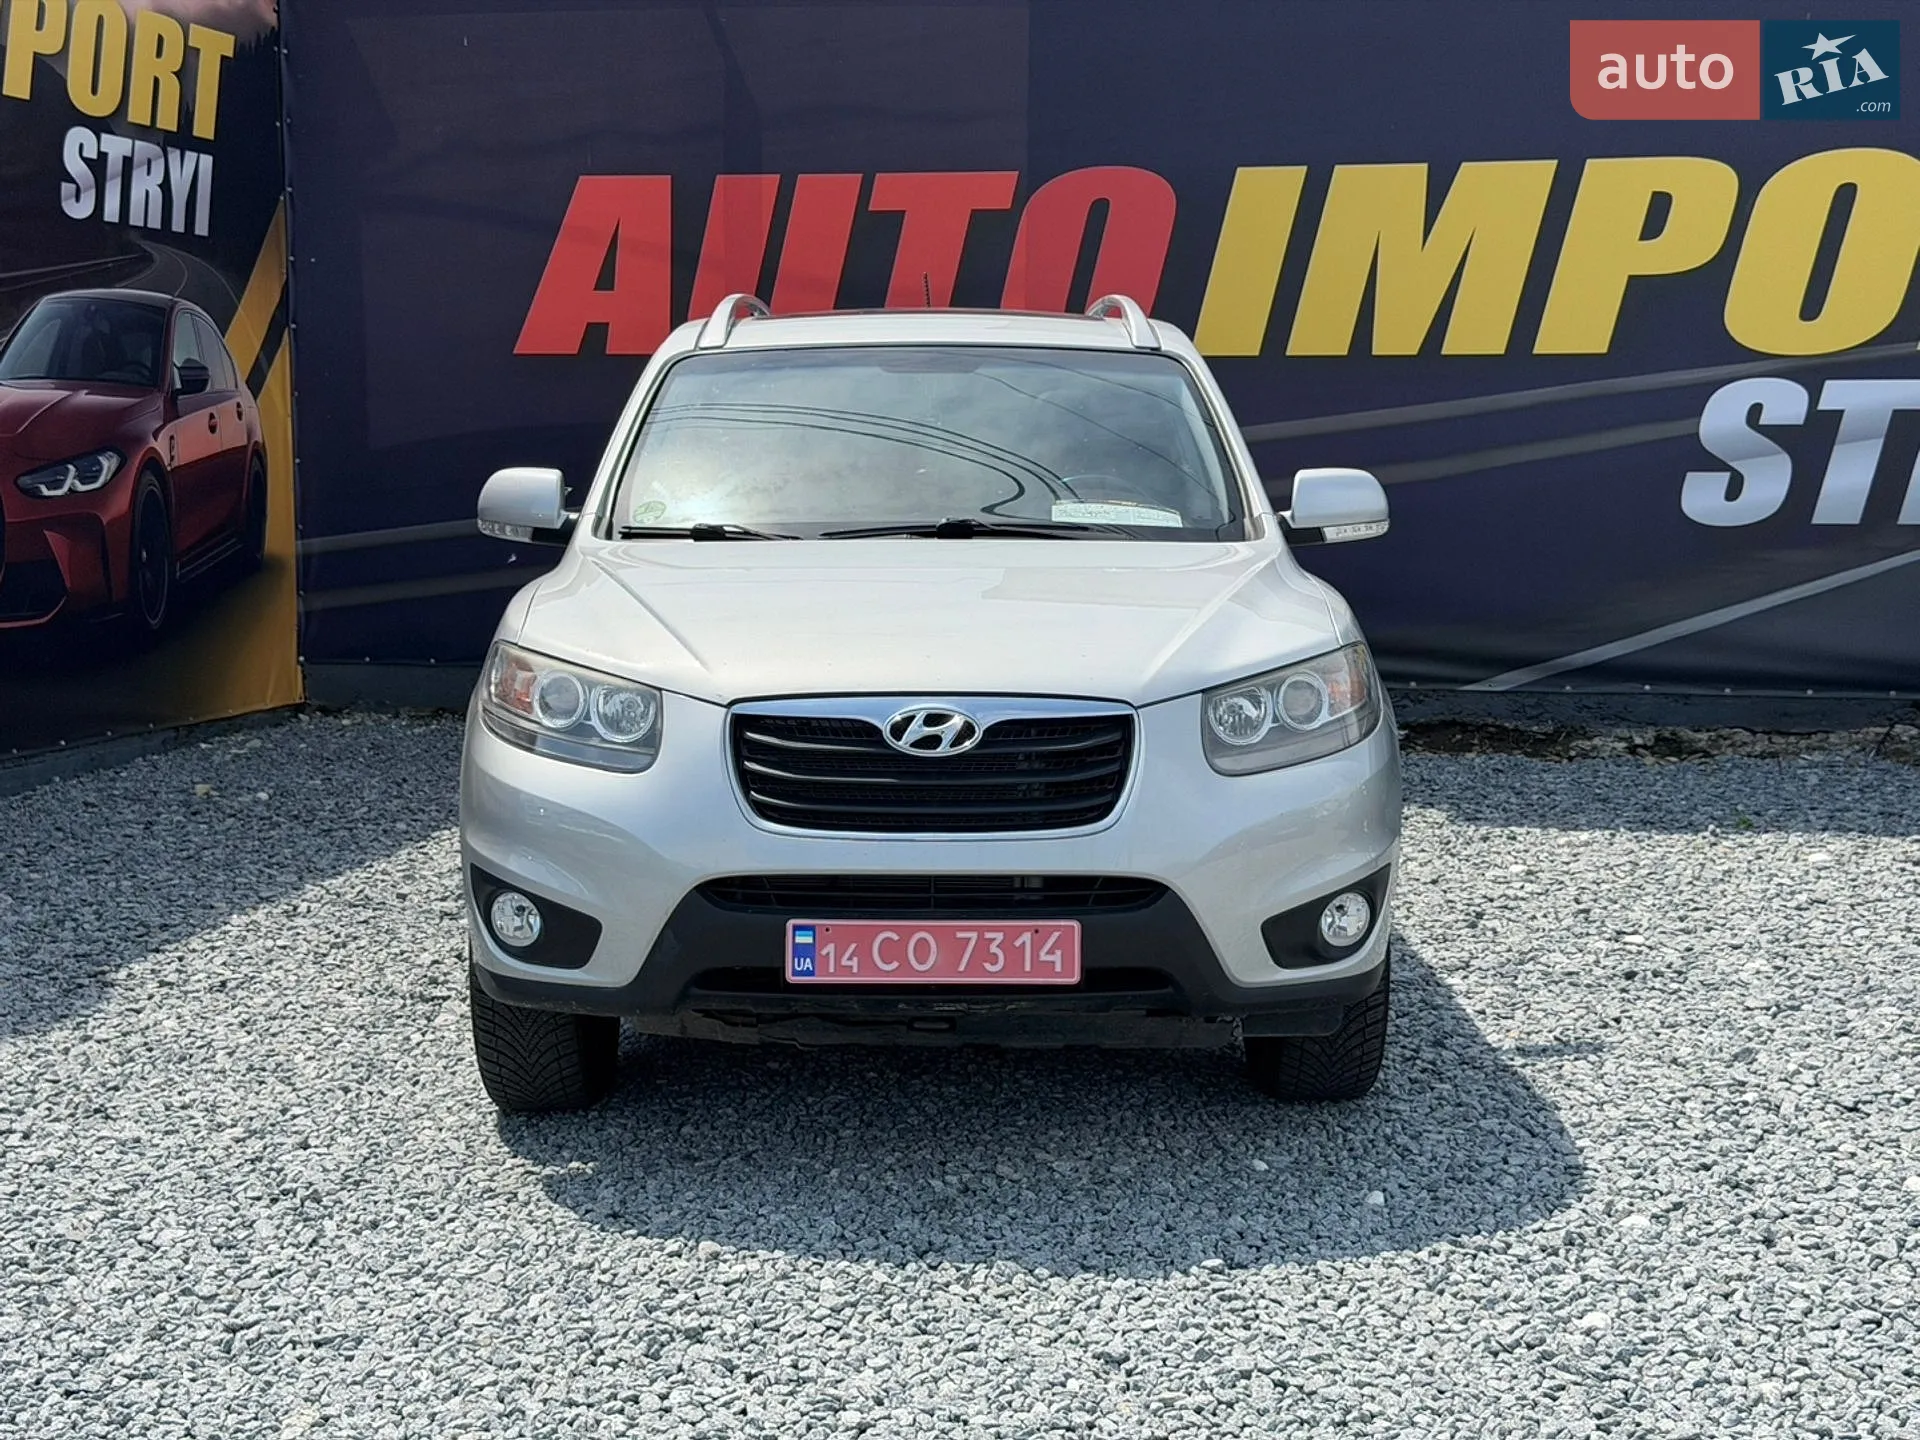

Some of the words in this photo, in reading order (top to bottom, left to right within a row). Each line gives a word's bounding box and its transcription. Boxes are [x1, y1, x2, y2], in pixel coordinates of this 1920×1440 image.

[0, 0, 236, 141] PORT
[60, 125, 214, 237] STRYI
[1193, 147, 1920, 357] IMPO
[794, 957, 813, 971] UA
[820, 942, 859, 974] 14
[871, 930, 938, 972] CO
[955, 930, 1064, 973] 7314
